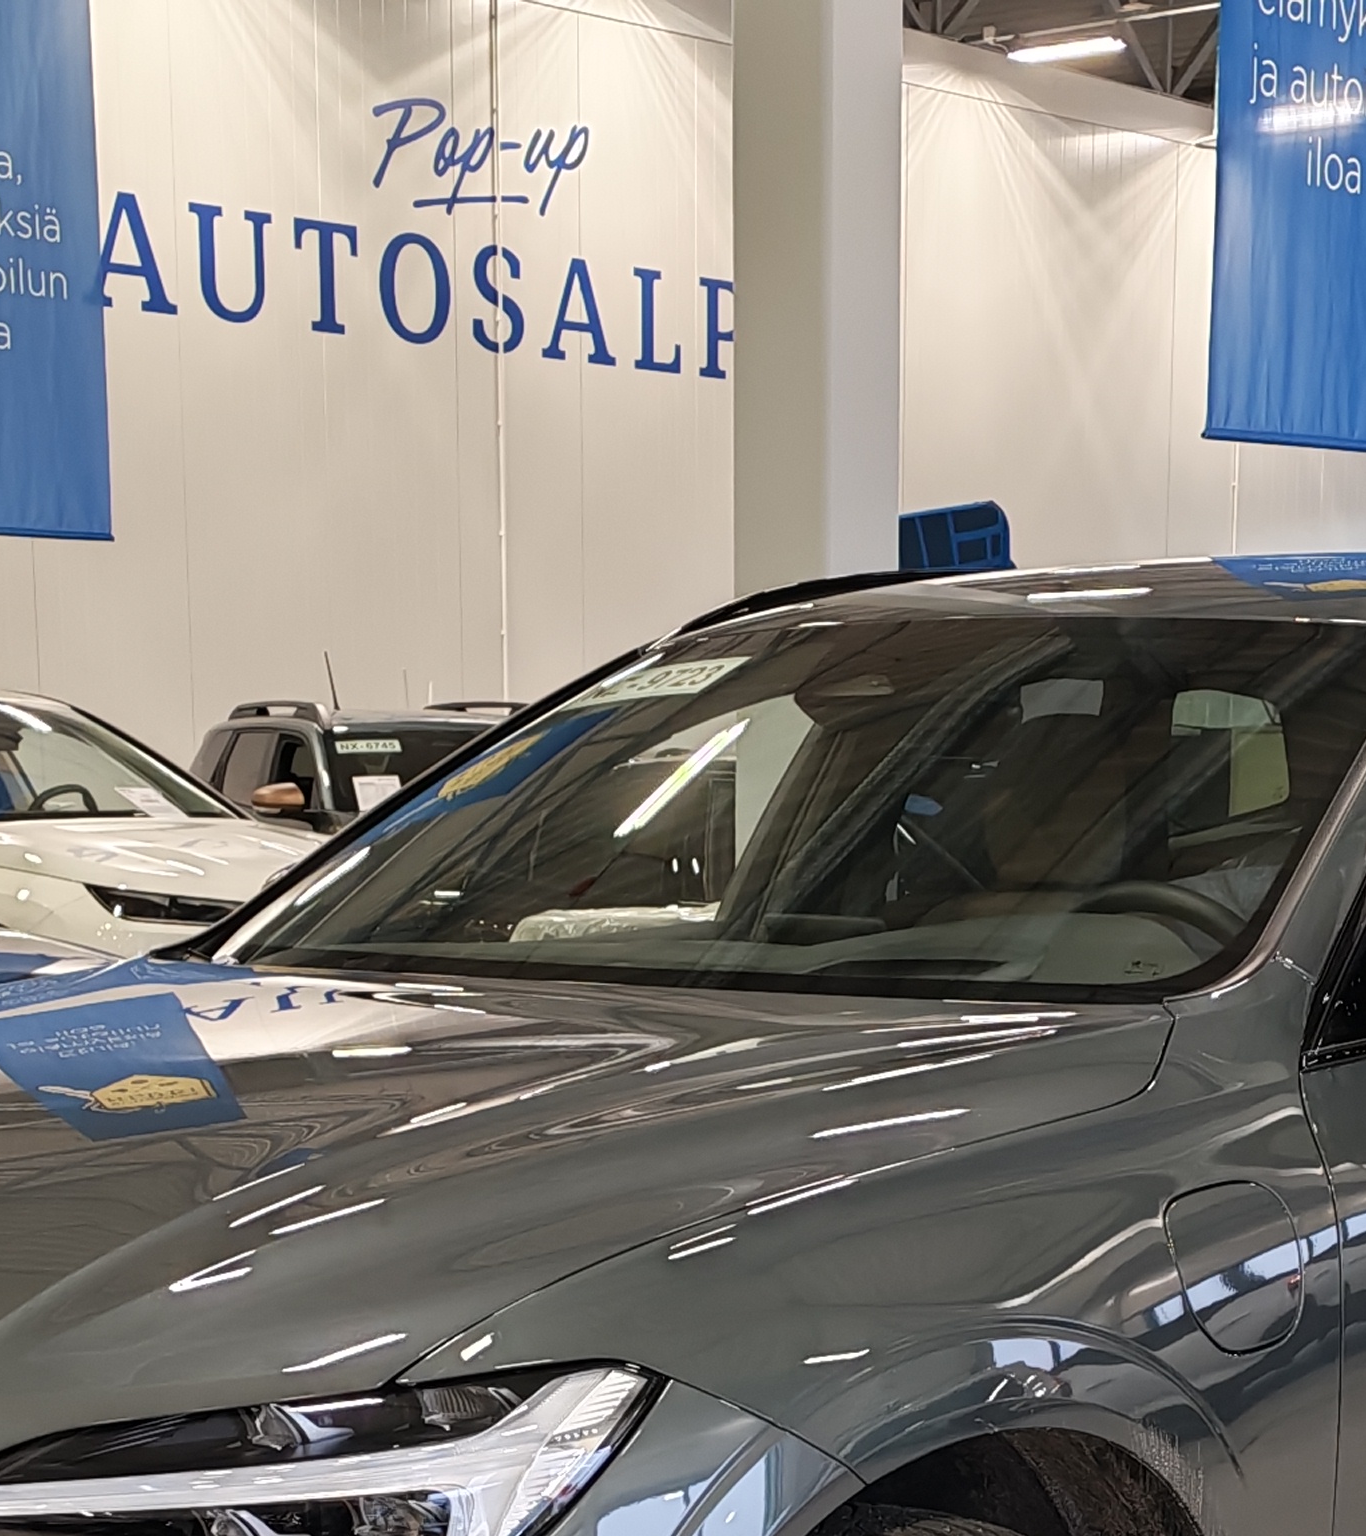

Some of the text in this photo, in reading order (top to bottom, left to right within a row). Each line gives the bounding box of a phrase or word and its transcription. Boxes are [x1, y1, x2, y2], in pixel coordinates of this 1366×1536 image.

[1249, 43, 1277, 104] ja
[372, 98, 589, 216] Pop-up
[1307, 137, 1361, 194] iloa
[339, 741, 396, 751] NX-6745
